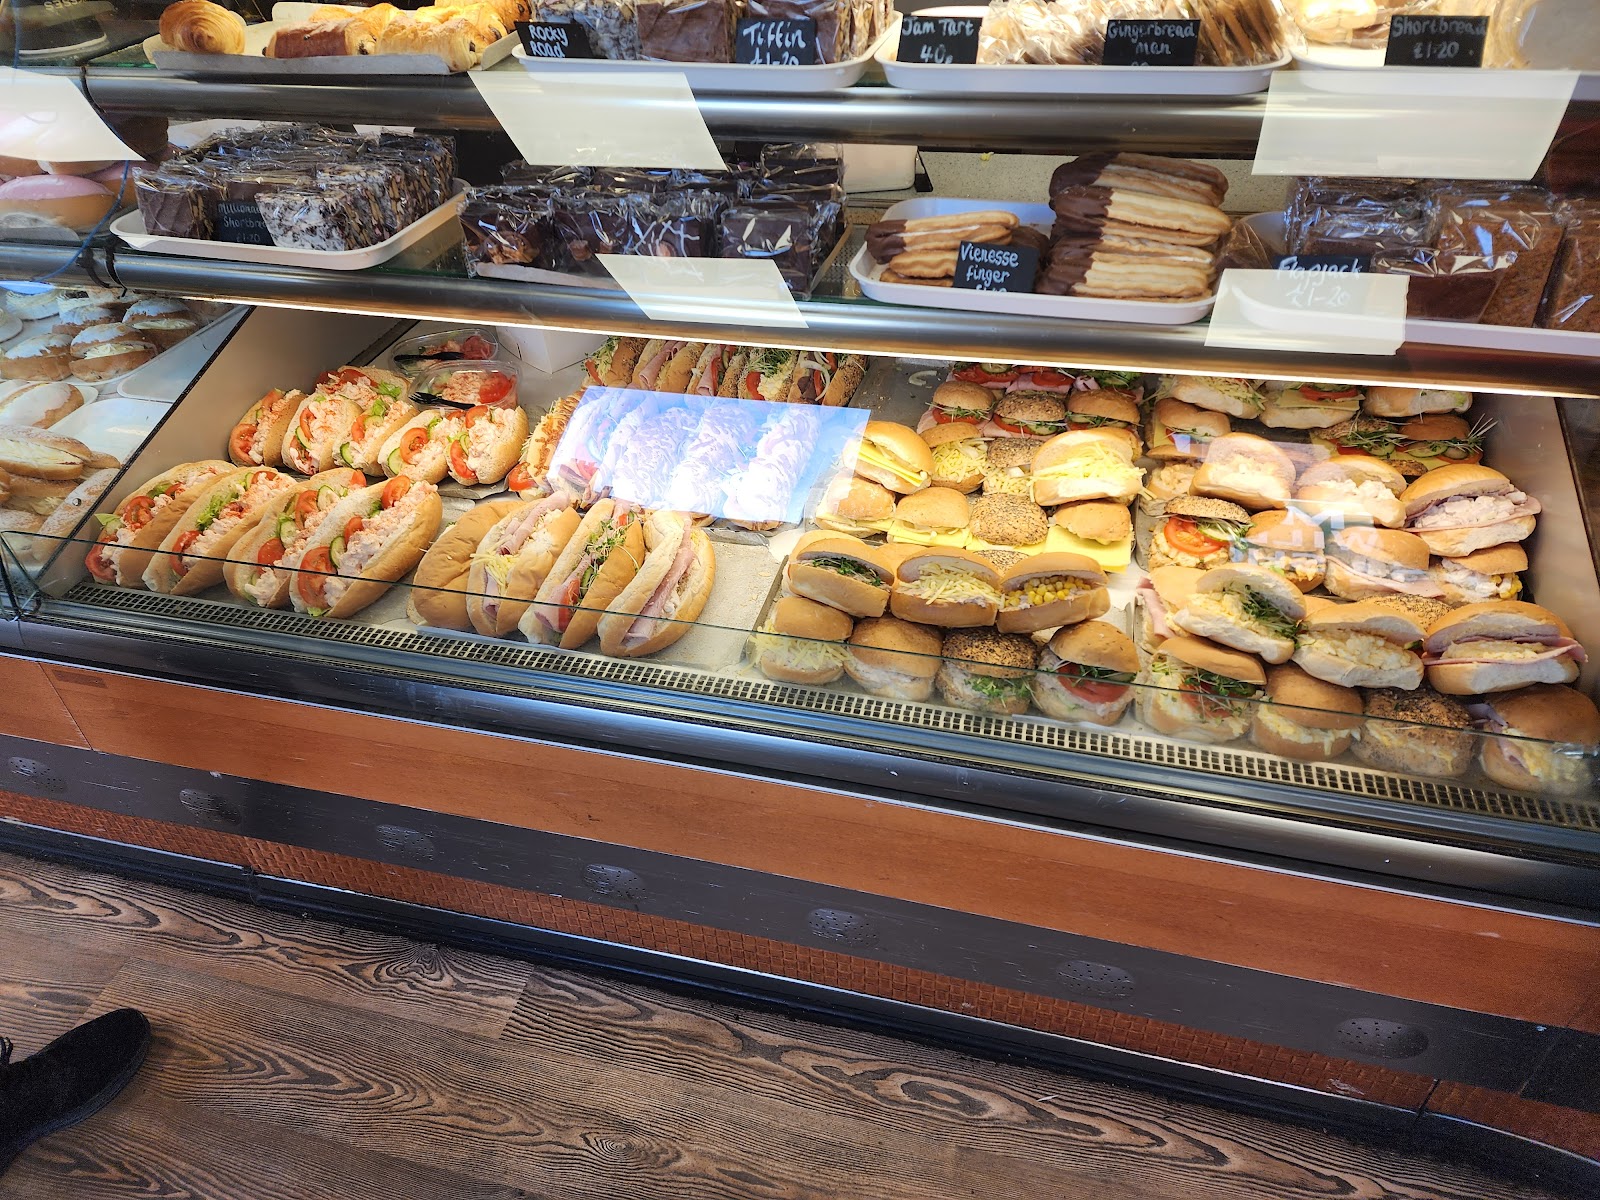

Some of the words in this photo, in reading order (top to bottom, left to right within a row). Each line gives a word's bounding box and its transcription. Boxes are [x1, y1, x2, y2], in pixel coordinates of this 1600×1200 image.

[742, 21, 806, 48] Tiffin
[902, 16, 936, 36] Jam
[938, 18, 975, 37] Tart
[1391, 16, 1487, 38] Shortbread
[961, 242, 1019, 268] Vienesse
[966, 264, 1010, 288] finger
[1277, 255, 1363, 291] Flapjack
